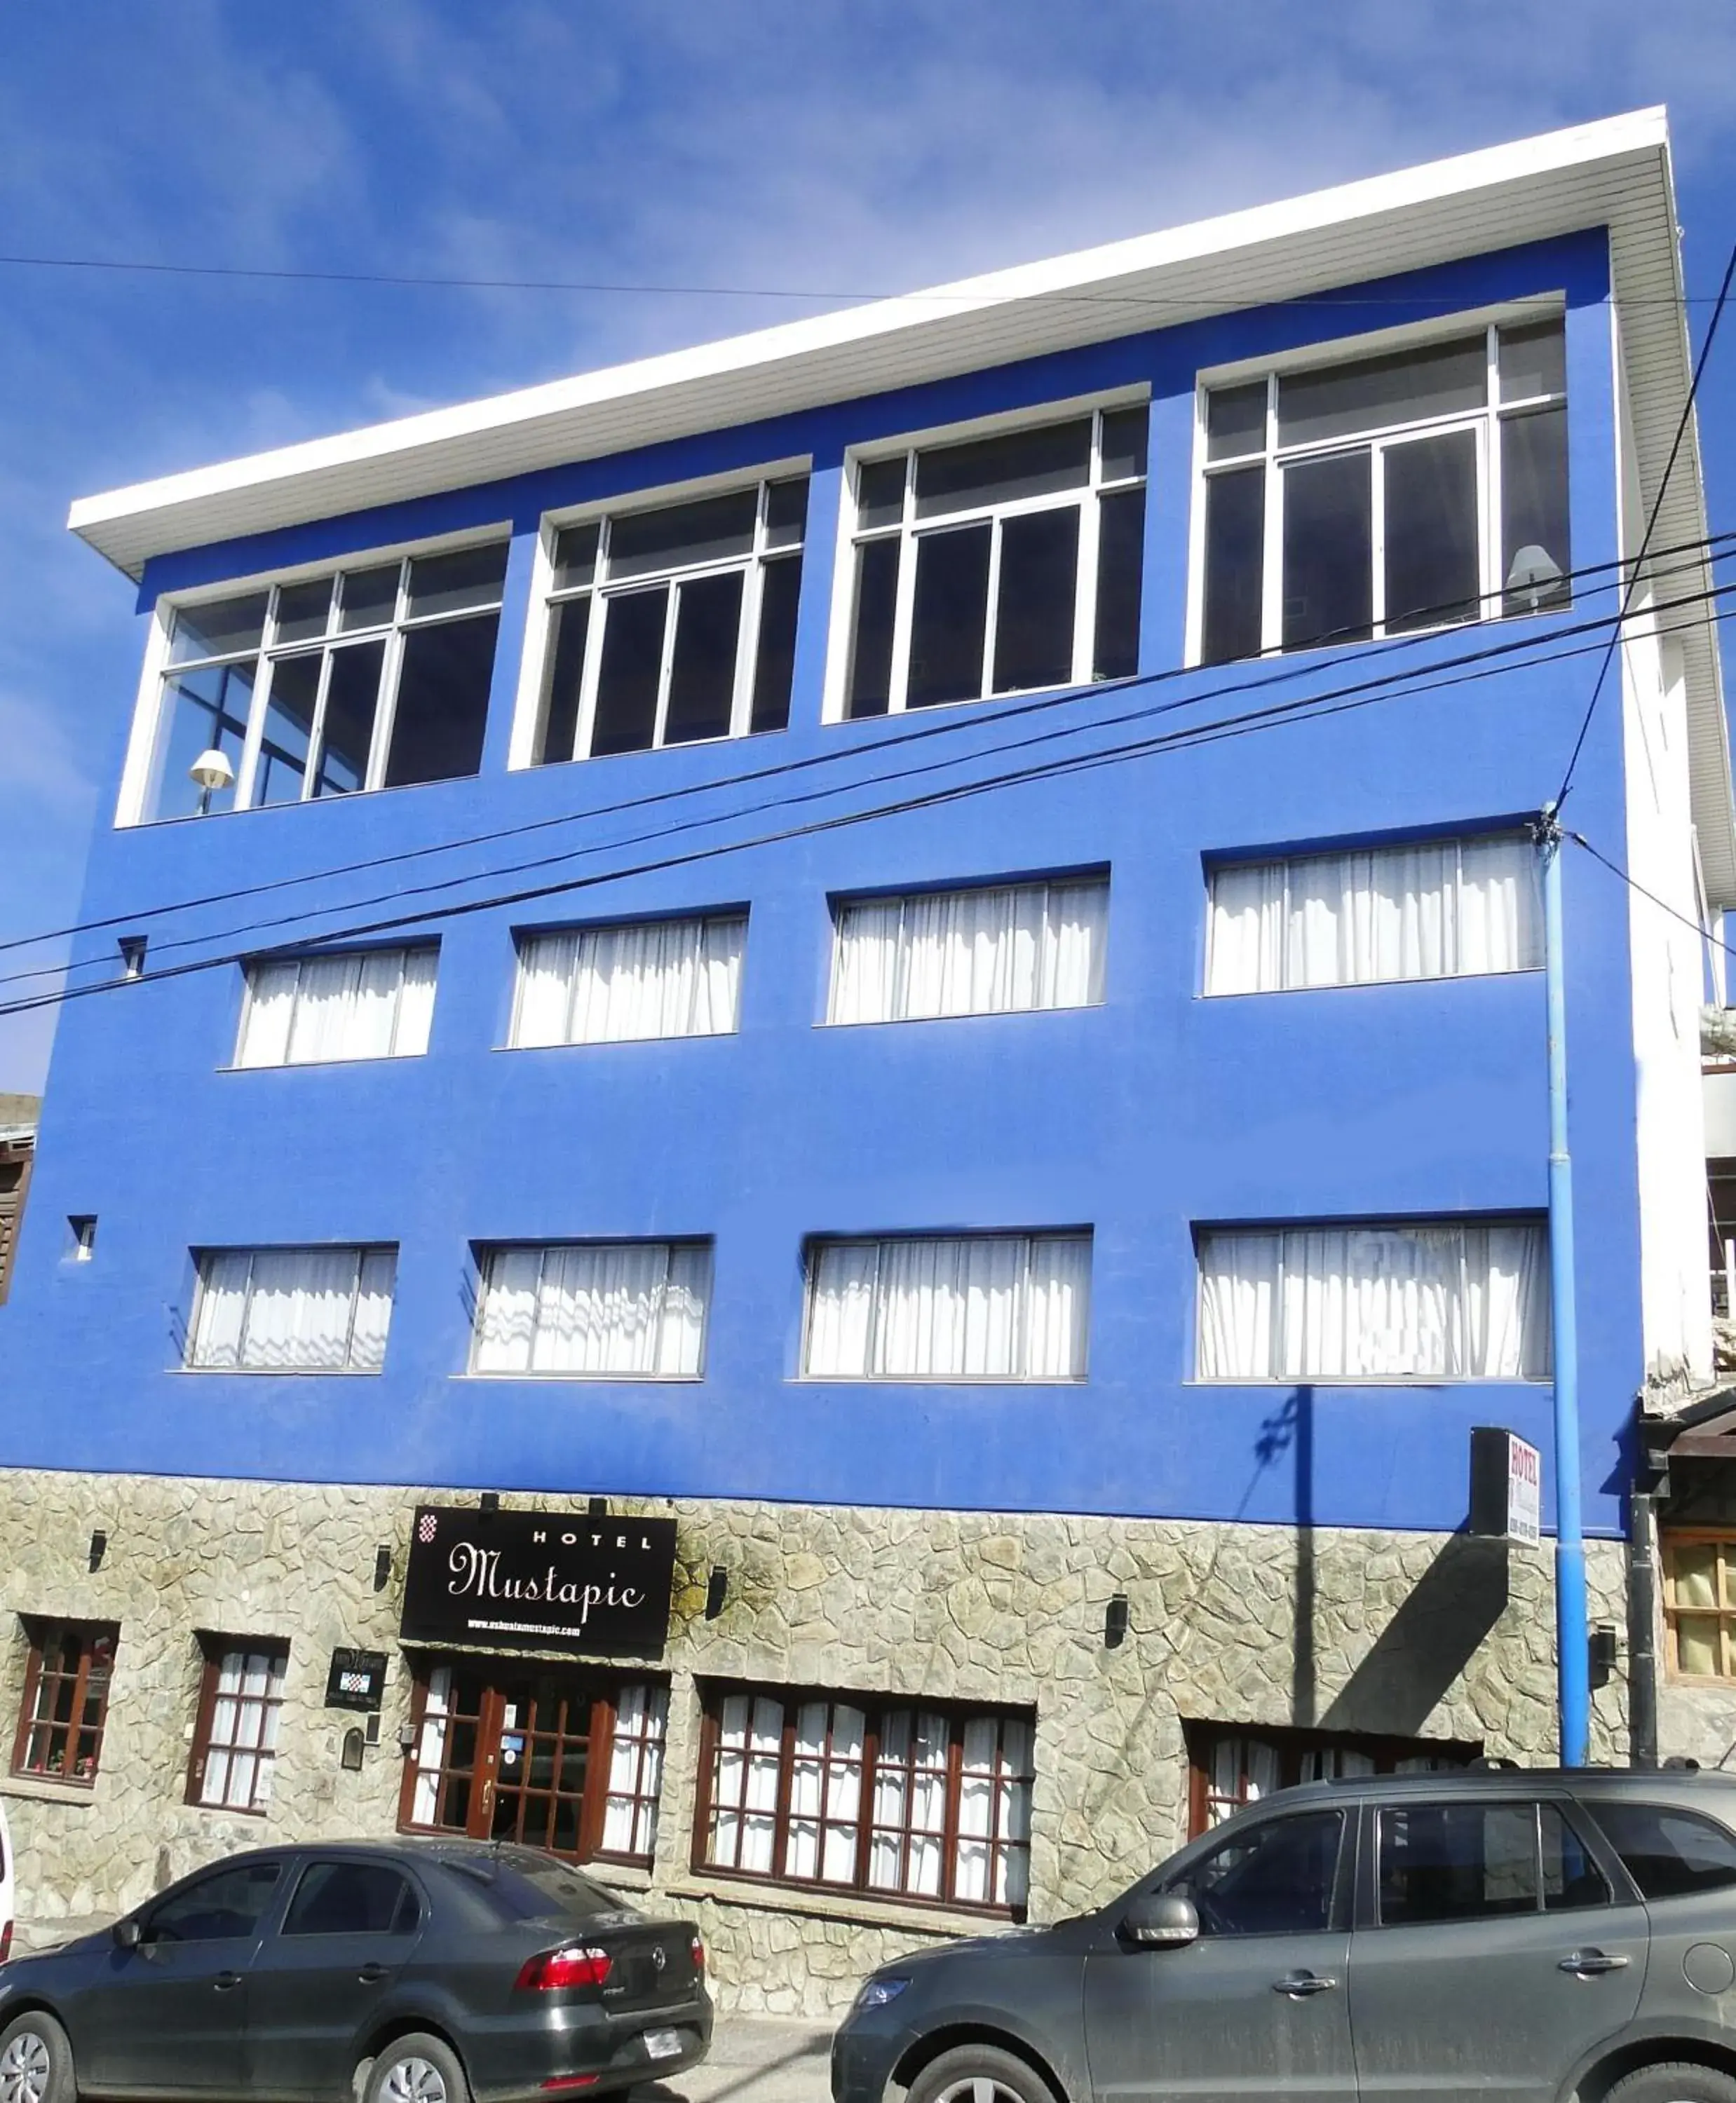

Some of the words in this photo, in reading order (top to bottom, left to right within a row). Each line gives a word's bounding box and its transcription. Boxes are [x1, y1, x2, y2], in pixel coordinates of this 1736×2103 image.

[1512, 1441, 1537, 1486] HOTEL
[533, 1531, 651, 1550] HOTEL
[448, 1541, 645, 1624] Mustapic
